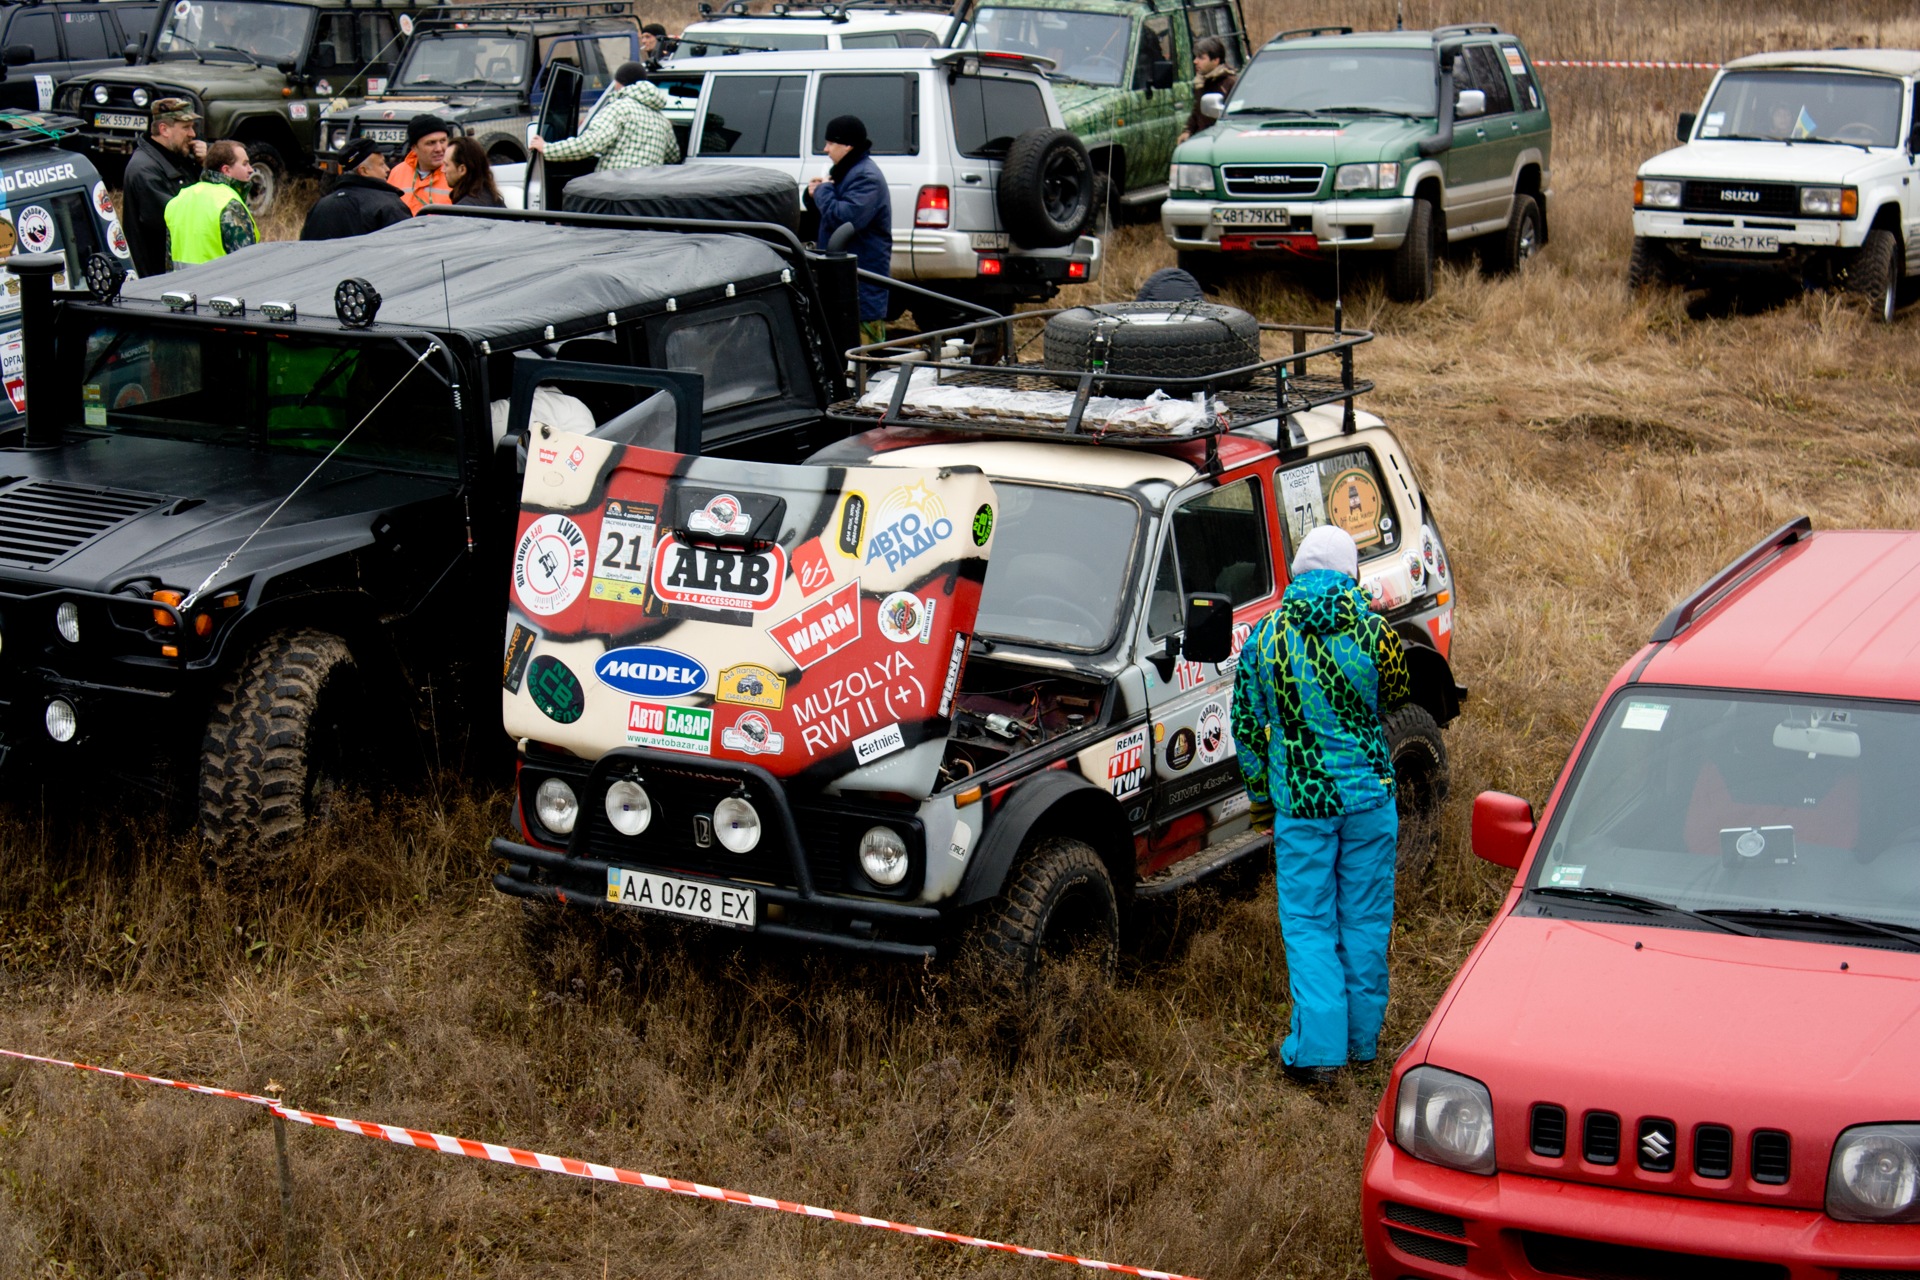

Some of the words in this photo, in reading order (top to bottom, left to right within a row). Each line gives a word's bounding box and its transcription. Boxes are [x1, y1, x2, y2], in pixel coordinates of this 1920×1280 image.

[113, 115, 132, 126] 5537
[1254, 175, 1290, 184] ISUZU
[1720, 190, 1760, 203] ISUZU
[1713, 234, 1753, 248] 402-17
[1282, 465, 1315, 481] ТИХОХОД
[1290, 476, 1311, 489] КВЕСТ
[530, 524, 543, 540] OFF
[558, 518, 583, 547] LVIV
[864, 514, 921, 567] АВТО
[518, 536, 532, 562] ROAD
[602, 531, 642, 572] 21
[516, 564, 525, 588] CLUB
[667, 547, 770, 596] ARB
[676, 592, 682, 601] 4
[692, 594, 698, 602] 4
[700, 595, 753, 609] ACCESSORIES
[786, 603, 855, 655] WARN
[539, 668, 573, 709] CB
[723, 671, 735, 682] 4x4
[736, 668, 765, 677] Rancho
[766, 674, 780, 690] Club
[792, 650, 915, 727] MUZOLYA
[1176, 661, 1205, 691] 112
[666, 709, 710, 737] БАЗАР
[801, 708, 851, 757] RW
[884, 675, 926, 720] (+)
[628, 734, 709, 752] www.avtobazar.ua
[1117, 732, 1144, 751] REMA
[1110, 745, 1143, 777] TIP
[1112, 766, 1146, 796] TOP
[608, 890, 619, 898] UA
[622, 875, 653, 904] AA
[662, 882, 712, 913] 0678
[721, 891, 750, 921] EX
